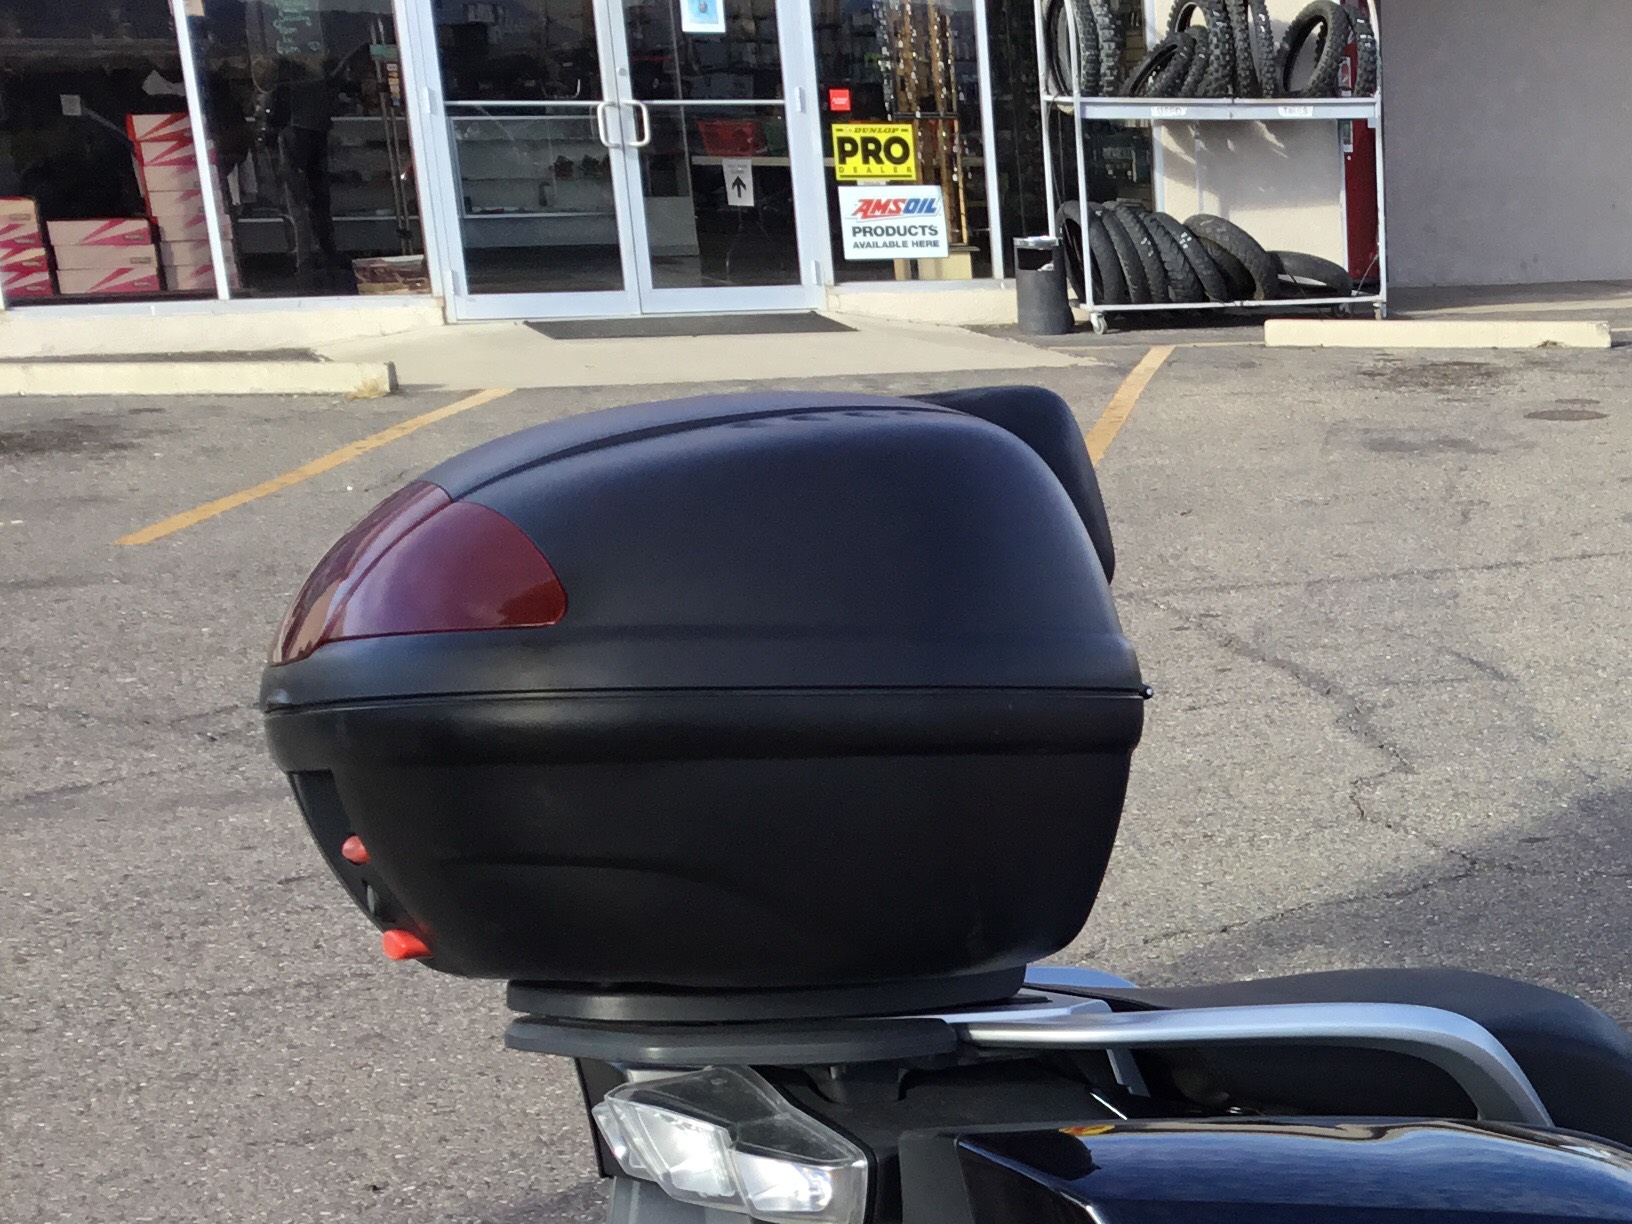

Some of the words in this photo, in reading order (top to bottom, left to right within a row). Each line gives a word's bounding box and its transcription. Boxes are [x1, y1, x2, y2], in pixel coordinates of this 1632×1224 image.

[836, 136, 910, 165] PRO
[851, 198, 937, 219] AMSOIL
[852, 225, 938, 237] PRODUCTS
[853, 240, 908, 249] AVAILABLE
[912, 239, 939, 247] HERE
